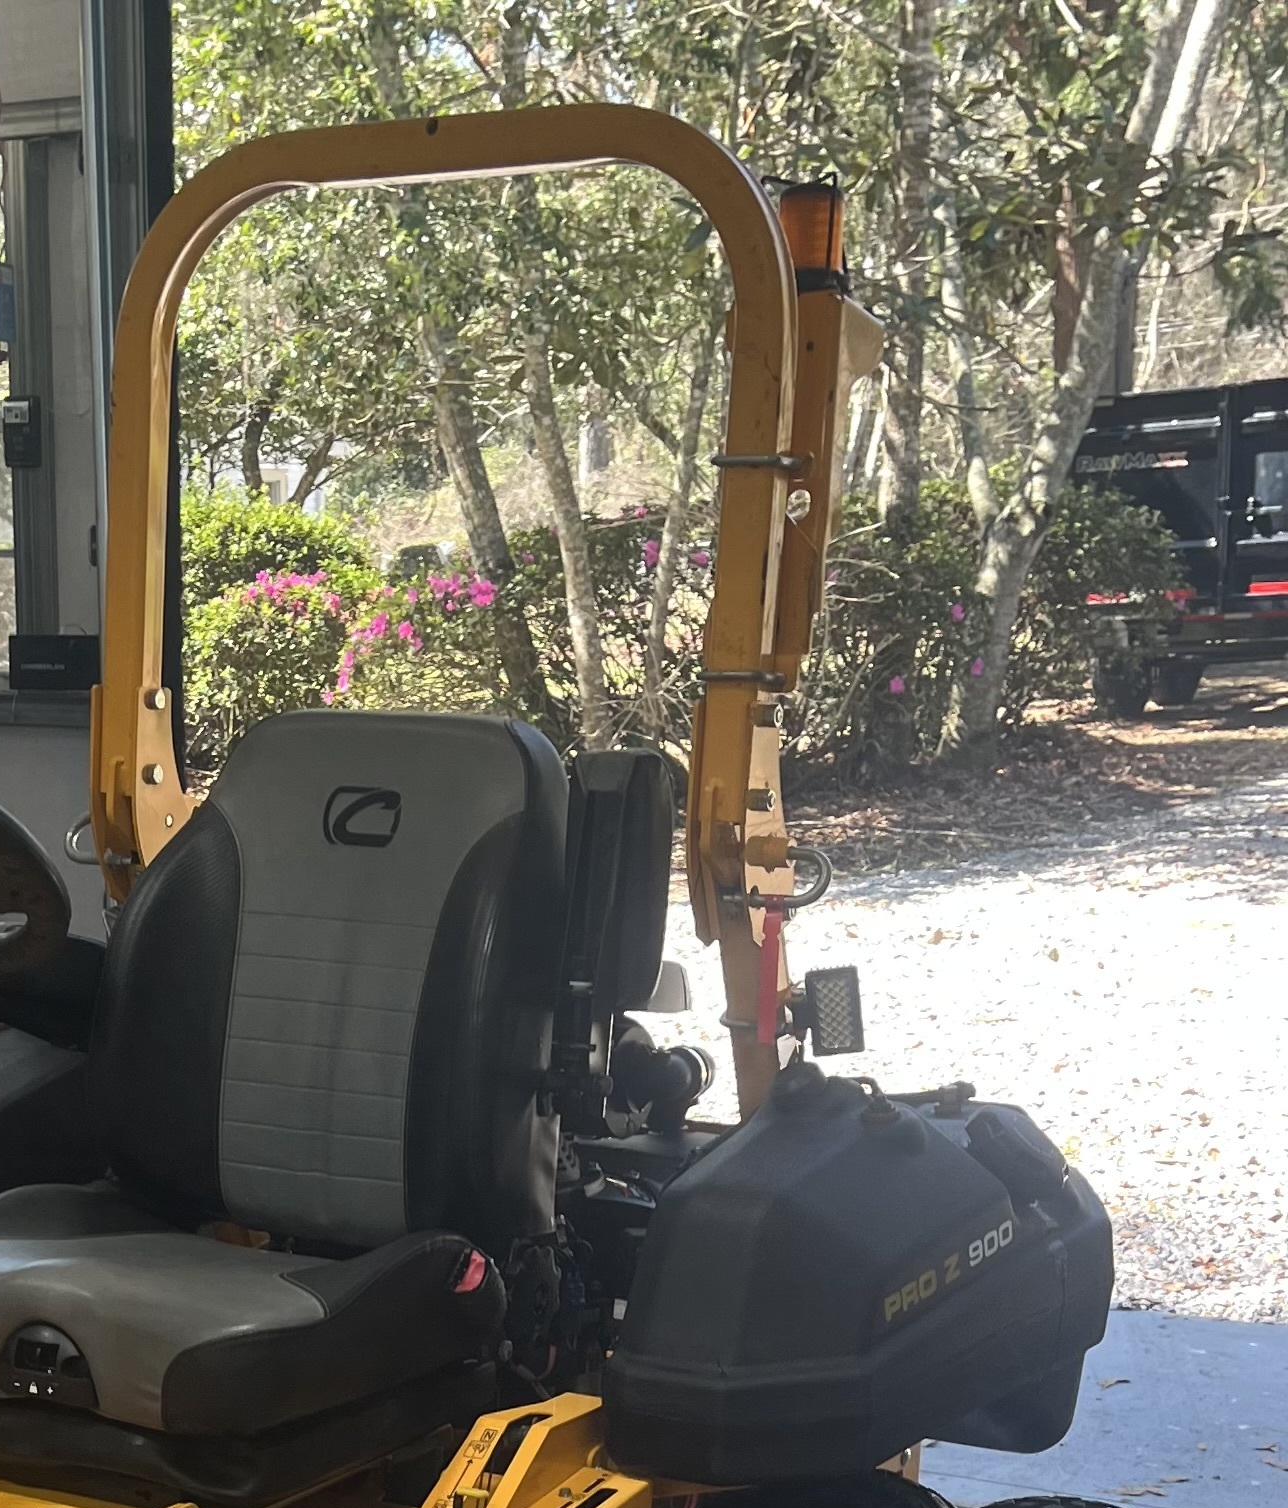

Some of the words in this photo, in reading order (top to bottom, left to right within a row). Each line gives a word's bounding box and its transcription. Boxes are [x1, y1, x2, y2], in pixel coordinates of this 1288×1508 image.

[884, 1268, 937, 1323] PRO
[943, 1252, 961, 1285] Z
[968, 1219, 1013, 1267] 900
